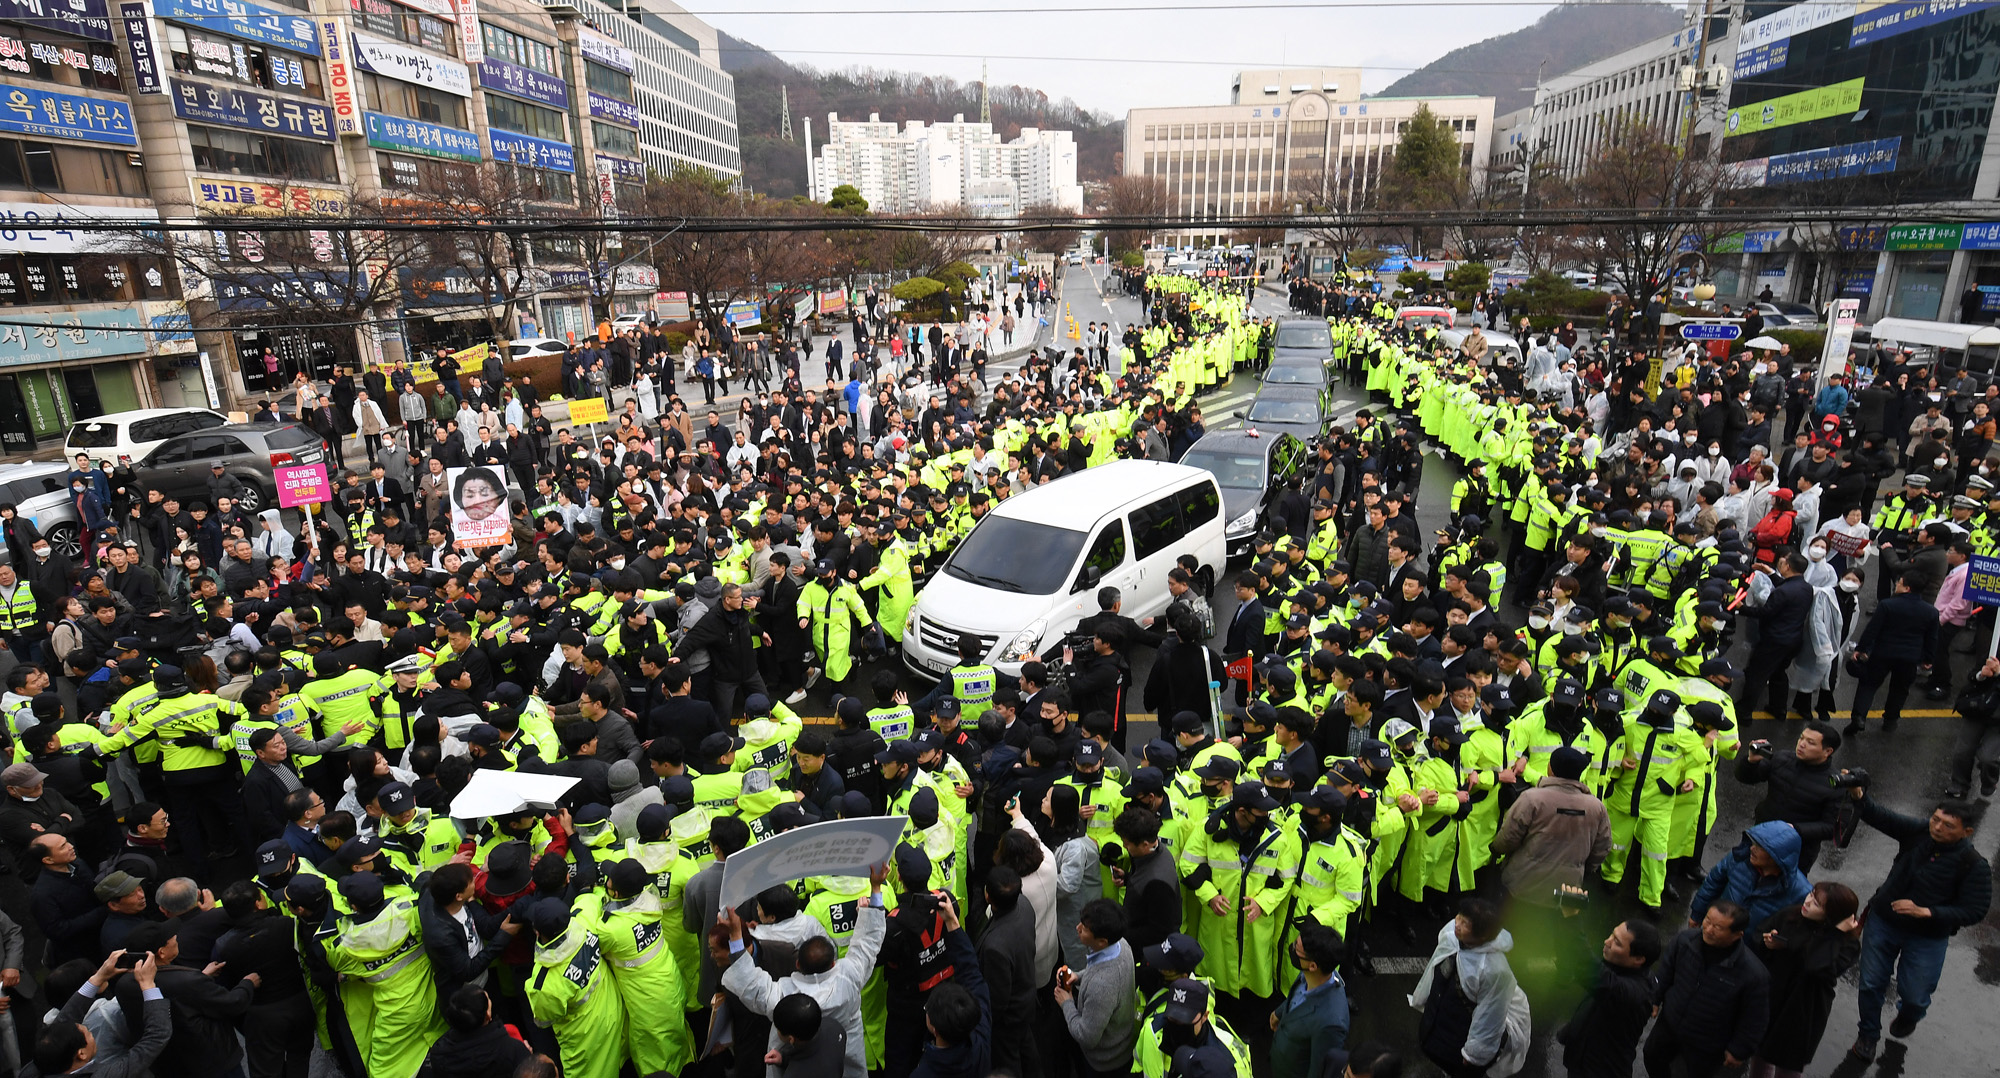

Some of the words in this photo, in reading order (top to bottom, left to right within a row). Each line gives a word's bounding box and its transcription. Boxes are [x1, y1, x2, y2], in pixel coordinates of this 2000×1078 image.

[222, 0, 314, 42] 빛고을
[1852, 20, 1875, 36] 법무법인
[1904, 4, 1926, 20] 변호사
[1760, 21, 1772, 39] 무진
[129, 21, 156, 74] 박연재
[322, 22, 342, 60] 빛고을
[369, 47, 392, 61] 변호사
[396, 55, 433, 82] 이영창
[1769, 54, 1786, 66] 7500
[483, 63, 501, 77] 변호사
[538, 81, 562, 95] 법률사무소
[329, 64, 352, 116] 공증
[5, 90, 36, 121] 옥
[41, 97, 128, 130] 법률사무소
[180, 85, 246, 115] 변호사
[256, 98, 329, 136] 정규련
[589, 95, 604, 111] 변호사
[22, 124, 84, 138] 226-8880
[385, 121, 404, 139] 변호사
[443, 133, 479, 150] 법률사무소
[550, 148, 573, 159] 법률사무소
[201, 183, 257, 205] 빛고을
[1890, 229, 1908, 241] 법무사
[1937, 228, 1957, 238] 사무소
[1965, 226, 1987, 240] 법무사
[2, 318, 88, 350] 서창원
[94, 322, 138, 340] 사무소
[287, 468, 316, 479] 역사왜곡
[294, 486, 316, 497] 전두환
[1631, 542, 1656, 550] POLIC
[321, 686, 360, 702] POLICE
[170, 713, 210, 730] POLICE
[847, 769, 870, 779] POLICE
[750, 818, 764, 833] 경
[757, 829, 776, 841] POL
[830, 904, 844, 920] 경
[833, 920, 856, 933] POL
[366, 939, 416, 971] POLICE
[919, 946, 946, 966] POLICE
